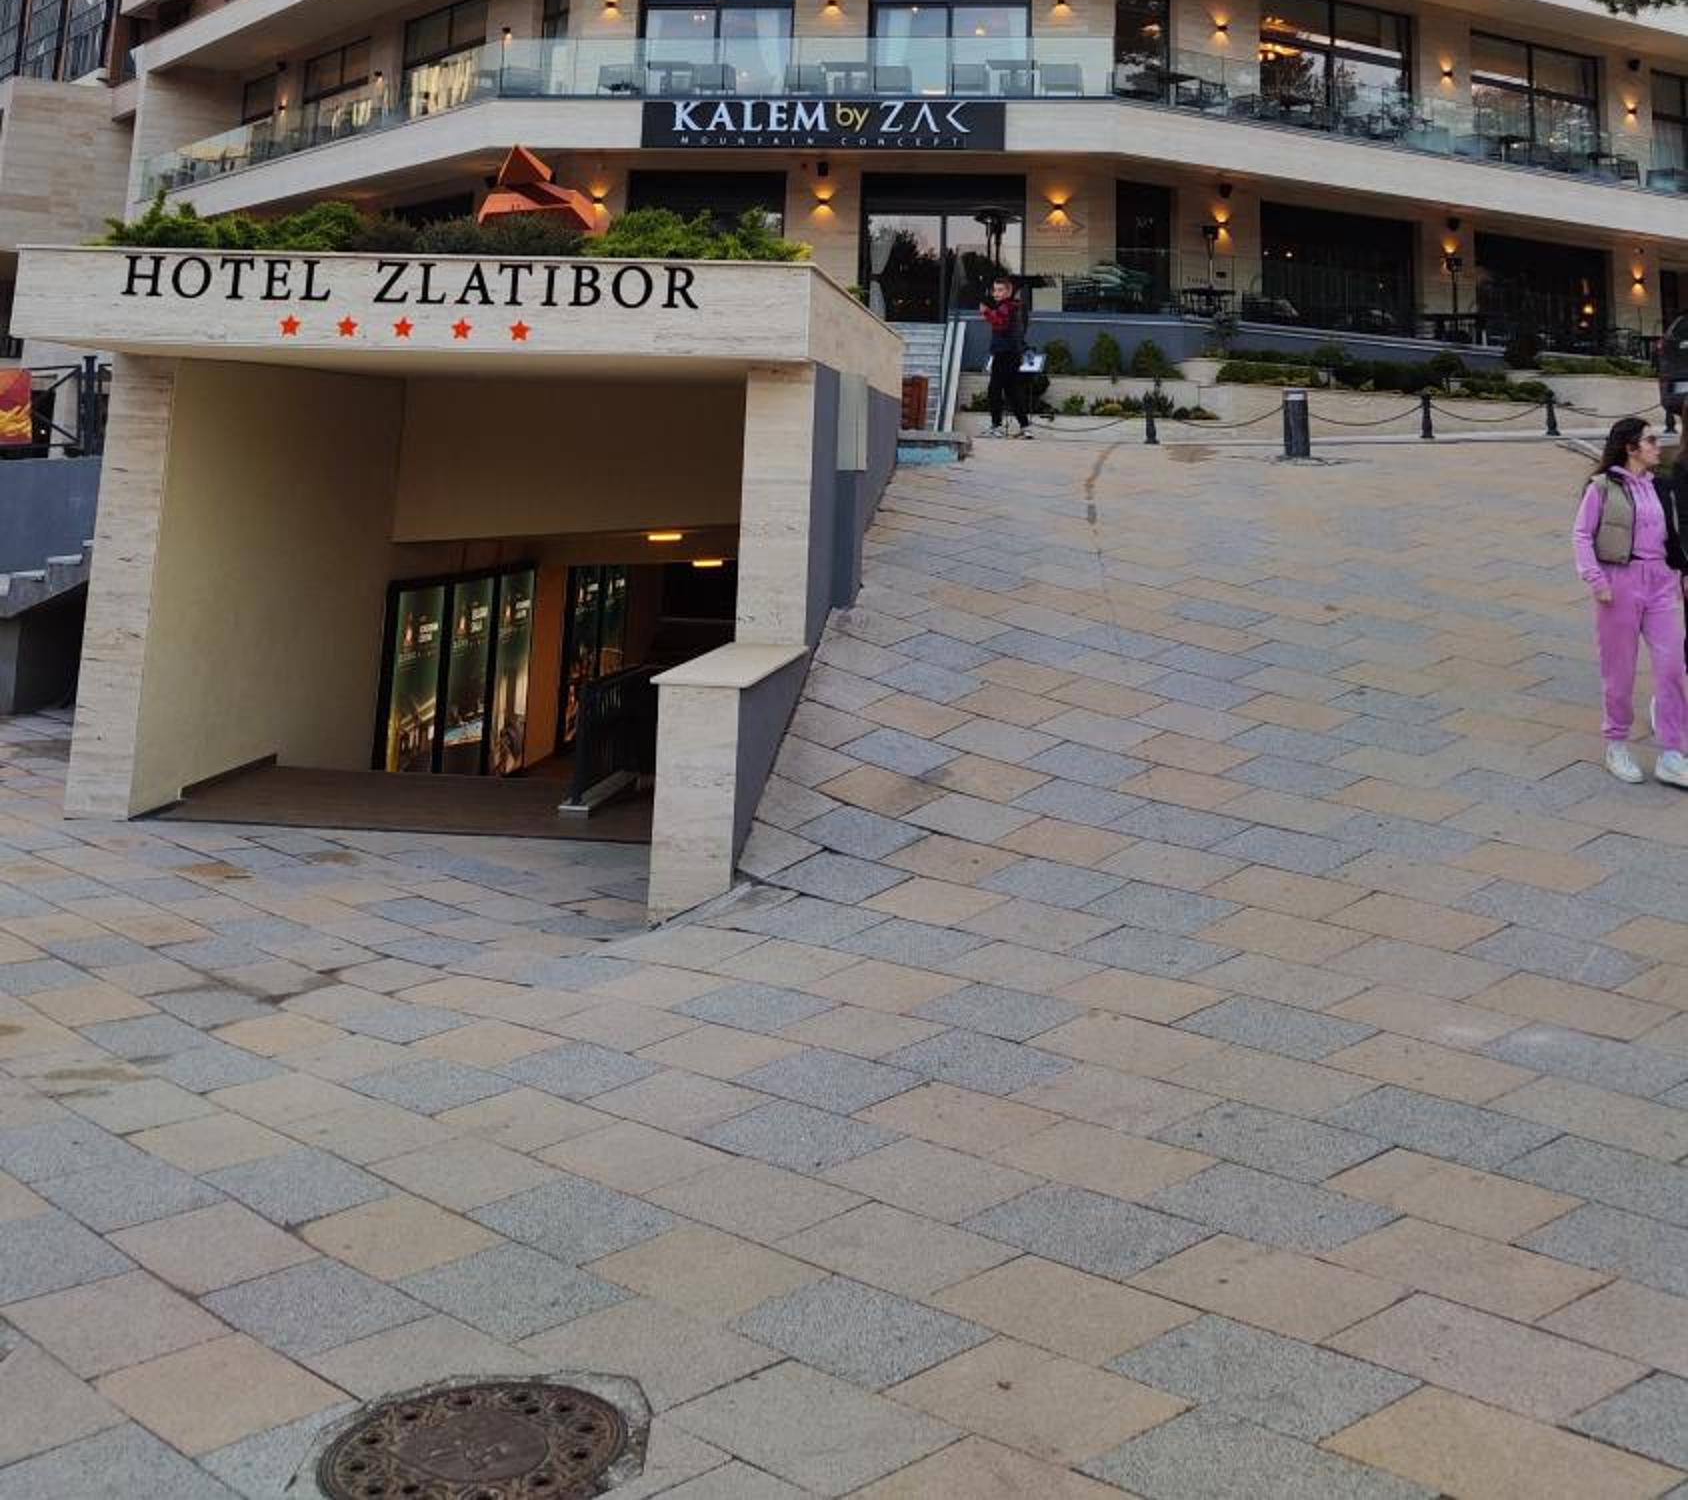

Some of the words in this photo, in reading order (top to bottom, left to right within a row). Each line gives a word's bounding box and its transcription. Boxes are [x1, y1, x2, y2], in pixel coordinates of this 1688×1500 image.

[672, 101, 830, 132] KALEM
[836, 102, 869, 132] by
[680, 135, 815, 146] MOUNTAIN
[841, 136, 958, 147] CONCEPT
[121, 255, 331, 301] HOTEL
[374, 261, 699, 310] ZLATIBOR
